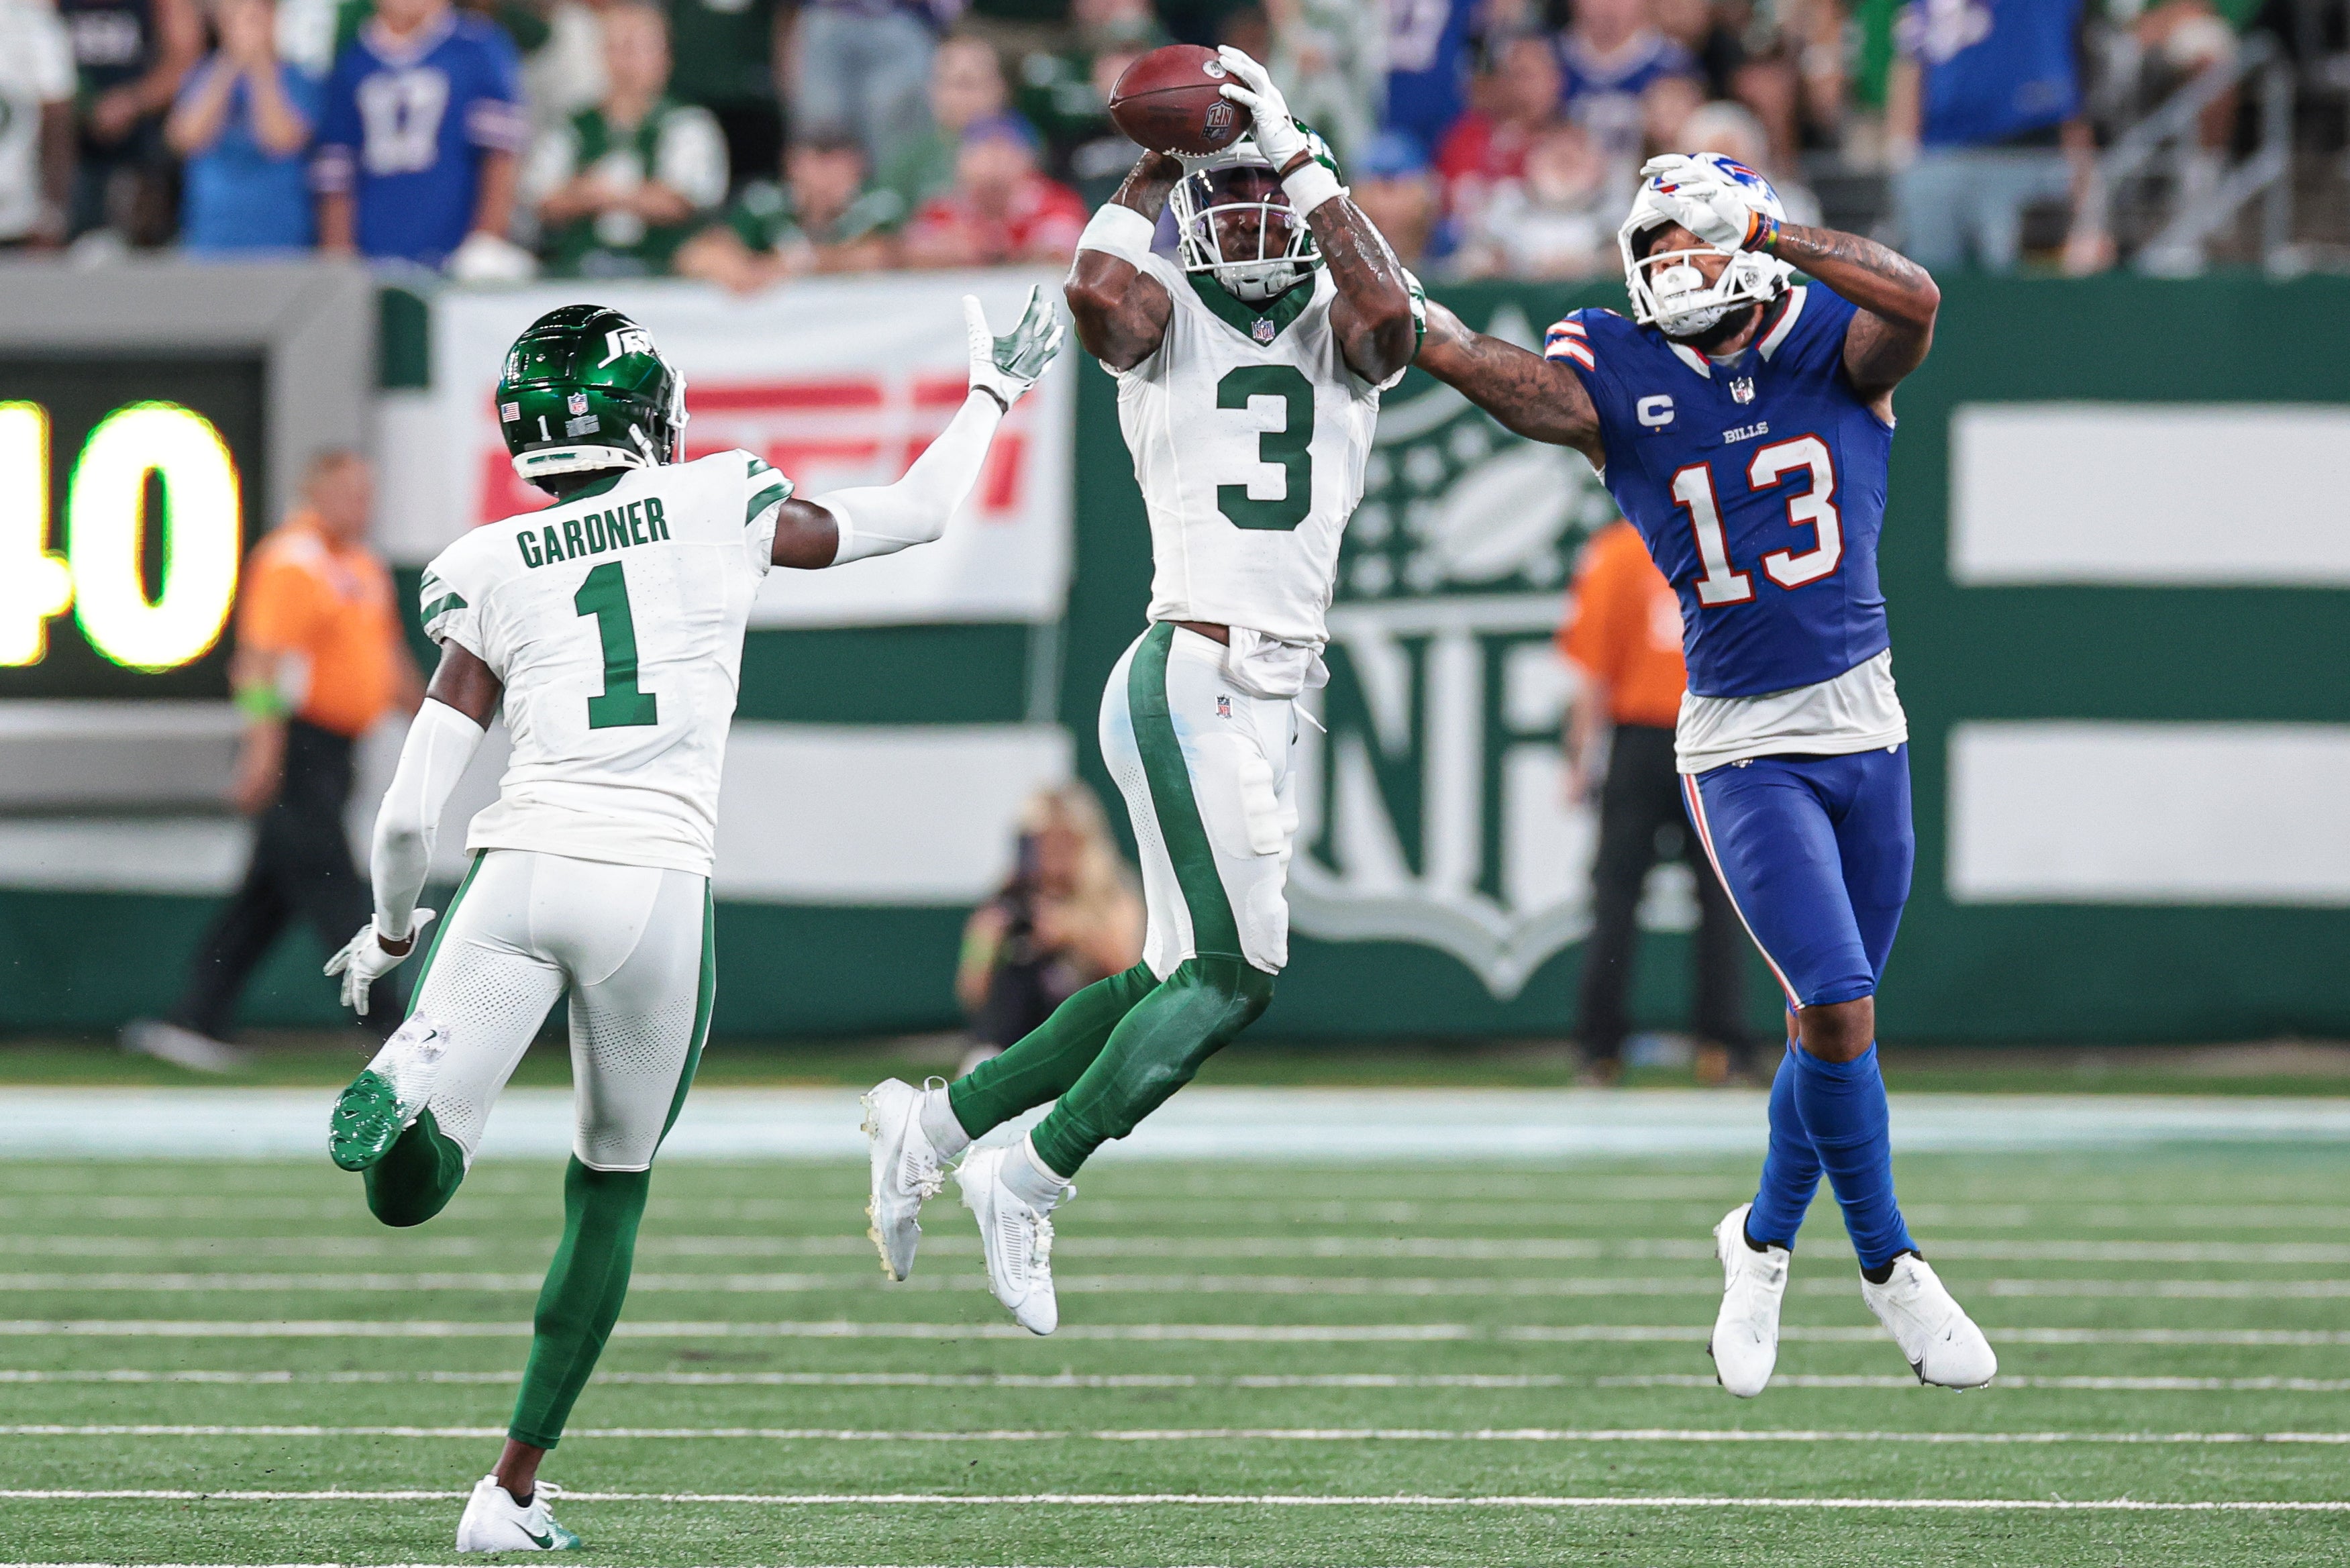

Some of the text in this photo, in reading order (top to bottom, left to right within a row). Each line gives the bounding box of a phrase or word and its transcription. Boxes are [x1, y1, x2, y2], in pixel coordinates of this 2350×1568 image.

[537, 415, 552, 441] 1
[1637, 394, 1675, 427] C
[1722, 421, 1769, 444] BILLS
[1217, 364, 1315, 531] 3
[516, 496, 671, 569] GARDNER
[1668, 431, 1845, 609] 13
[574, 560, 658, 730] 1
